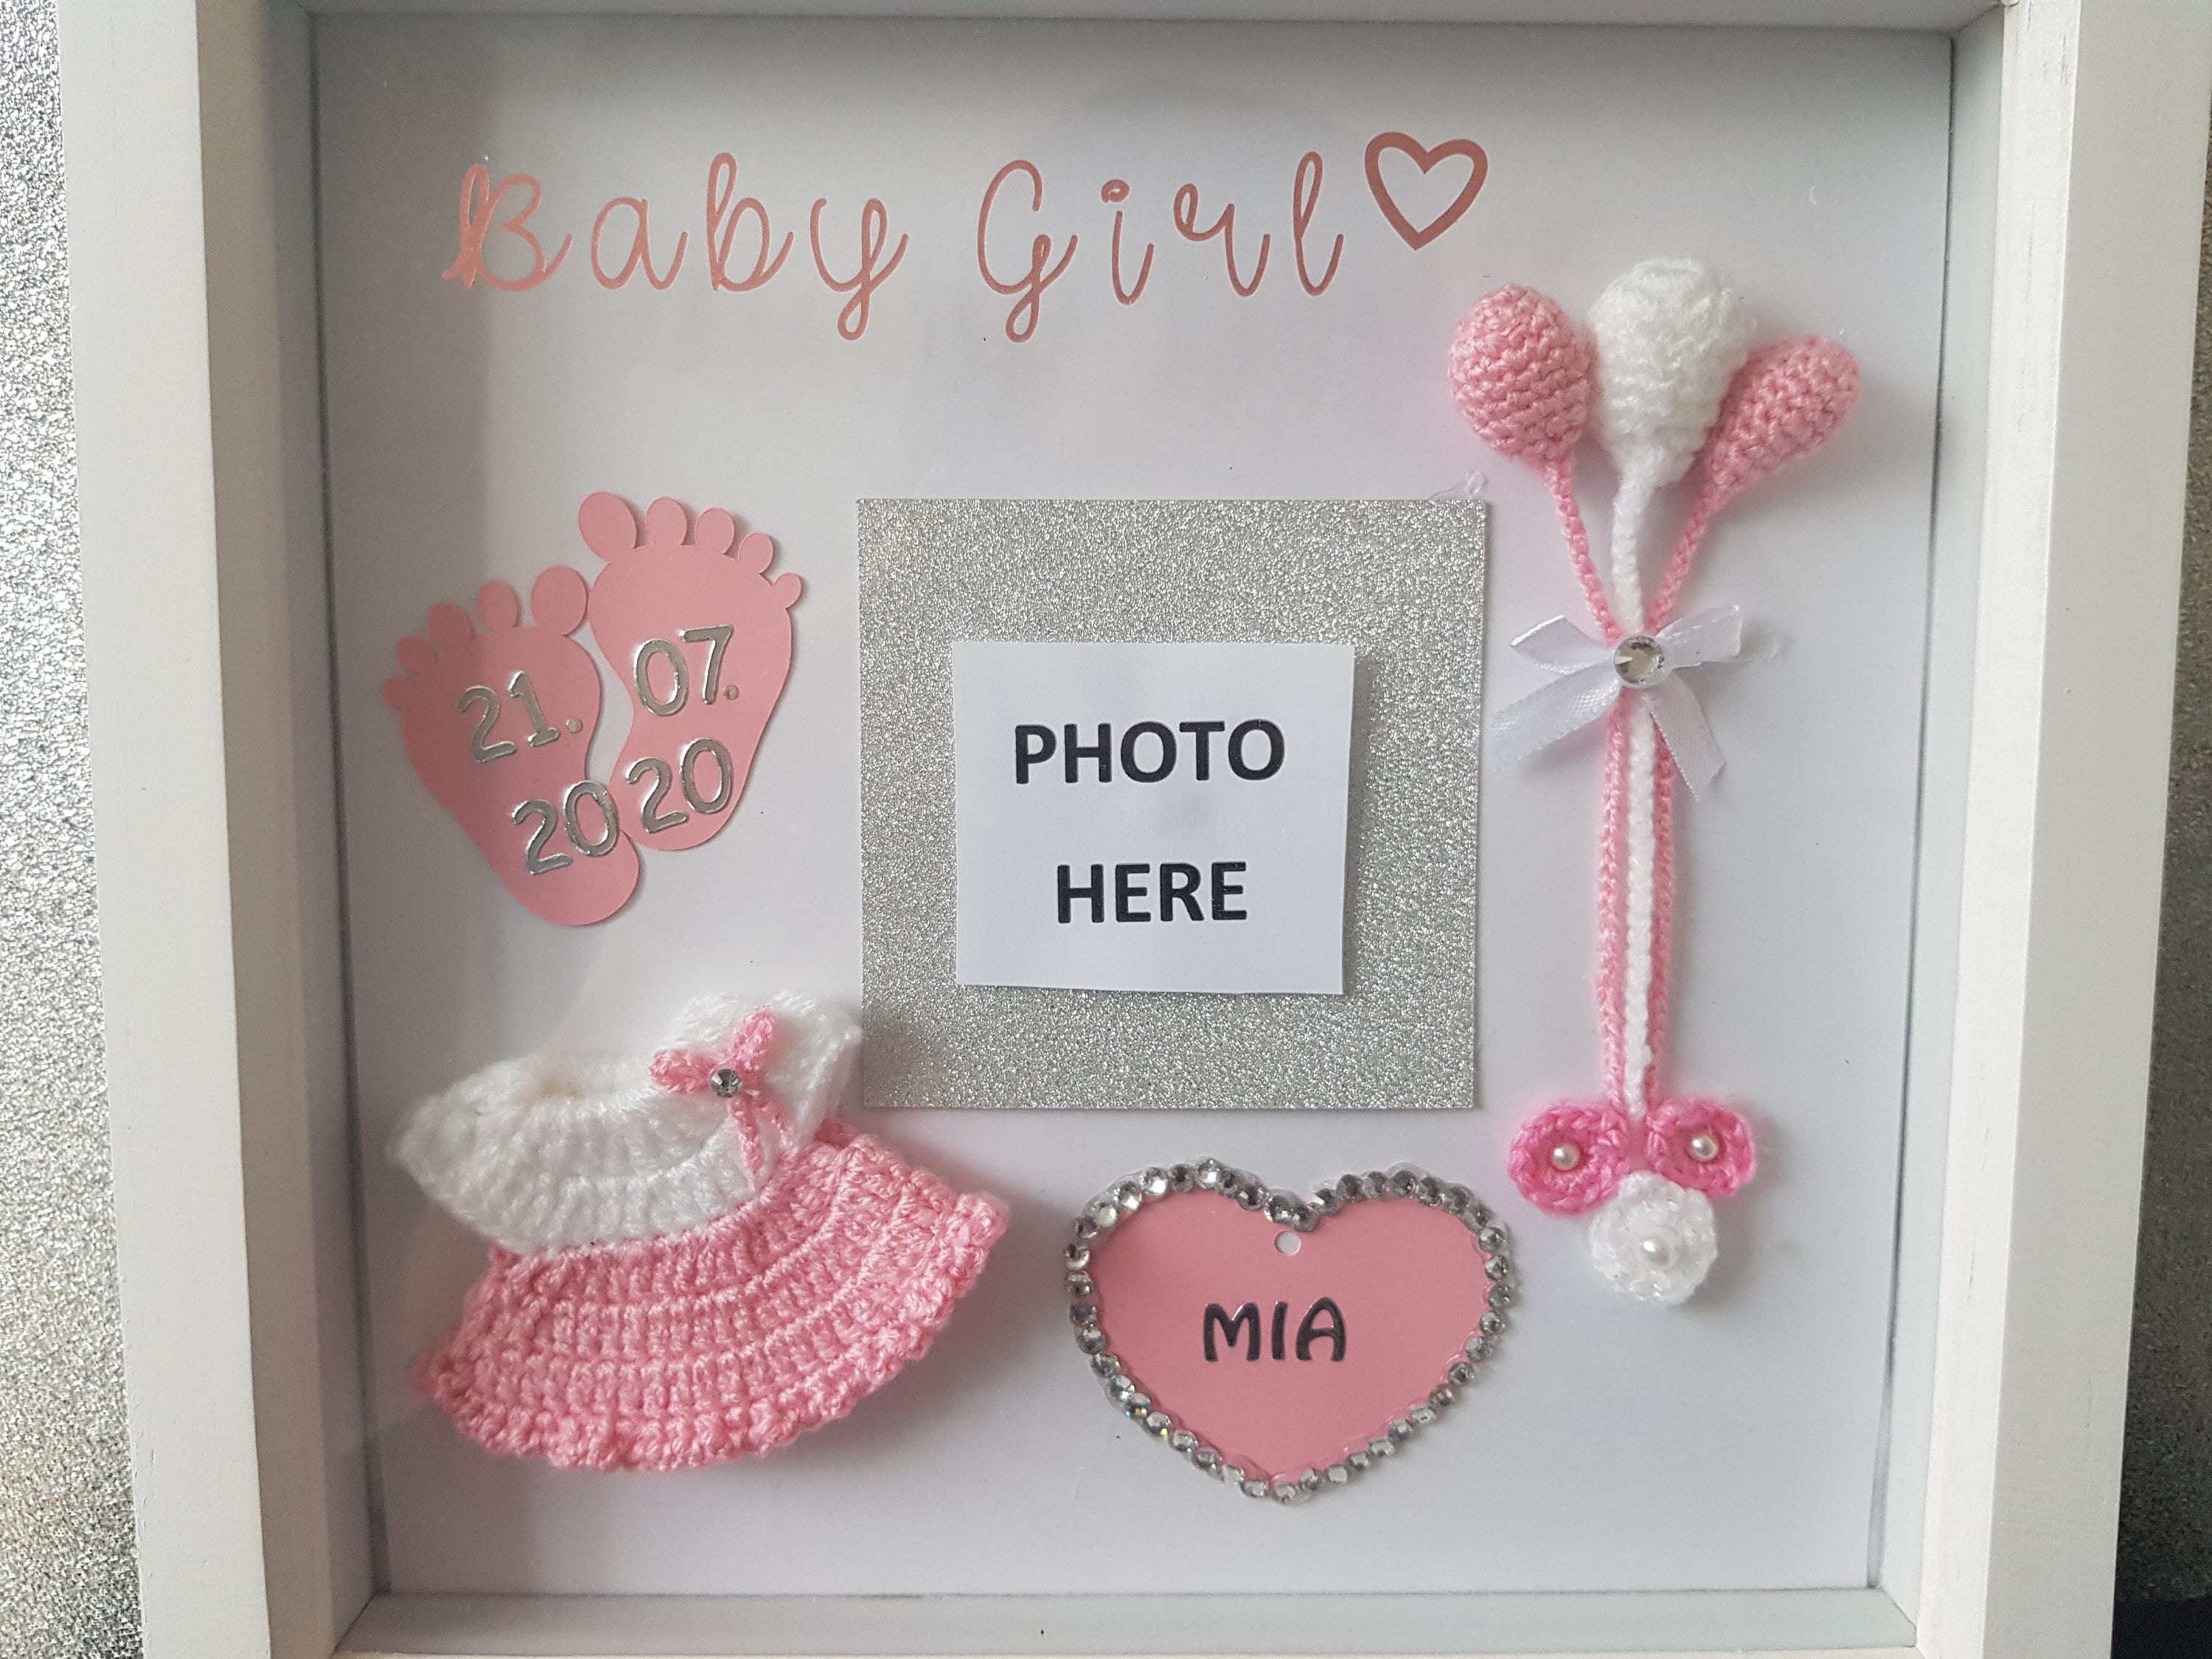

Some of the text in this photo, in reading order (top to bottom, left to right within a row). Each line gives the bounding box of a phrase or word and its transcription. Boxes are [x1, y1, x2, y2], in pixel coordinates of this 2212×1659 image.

[442, 150, 1344, 343] Baby Girl
[1014, 718, 1286, 785] PHOTO
[1056, 861, 1248, 924] HERE
[1203, 1295, 1347, 1363] MIA
